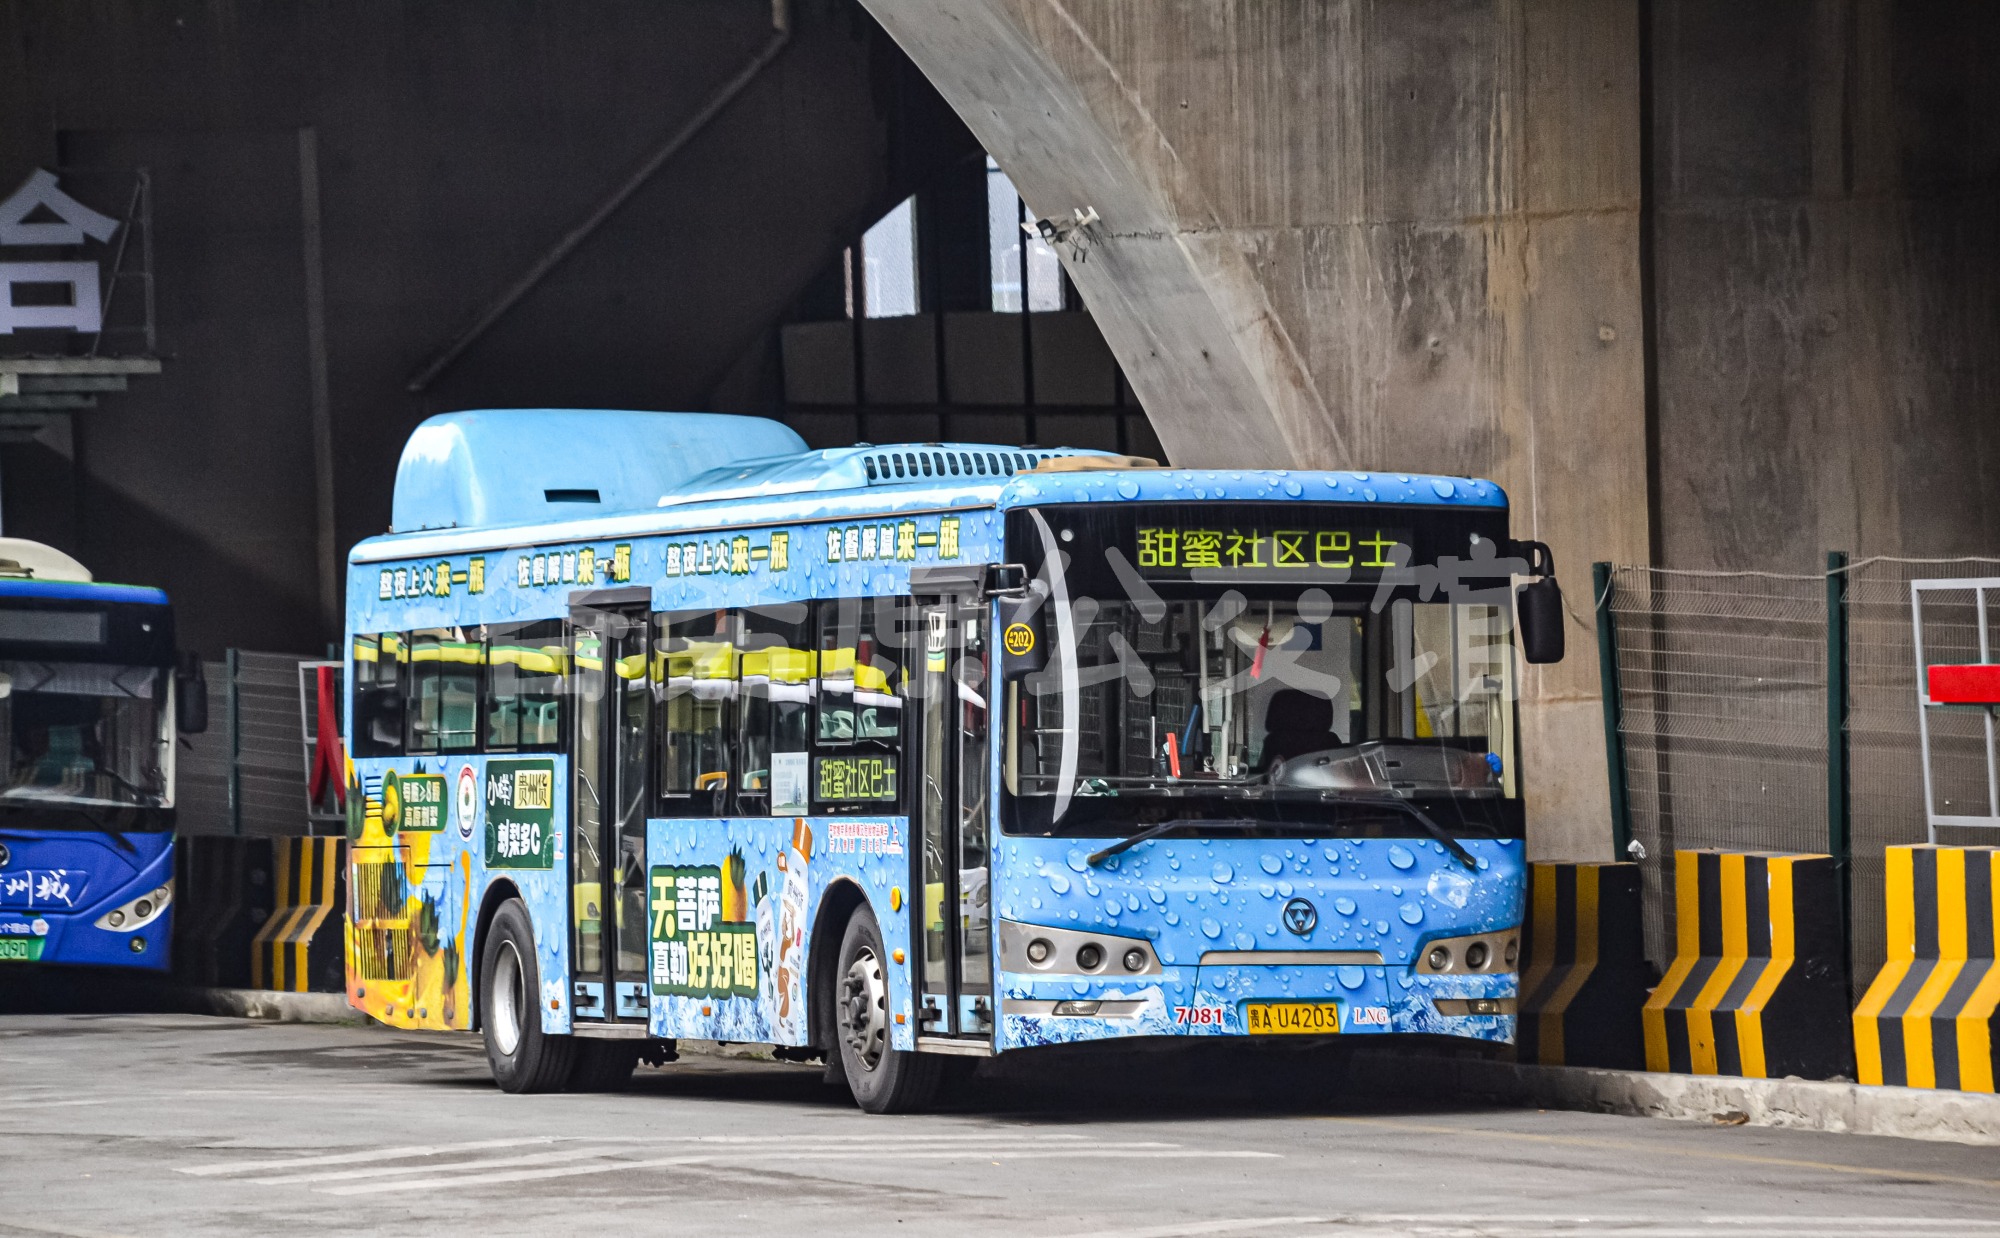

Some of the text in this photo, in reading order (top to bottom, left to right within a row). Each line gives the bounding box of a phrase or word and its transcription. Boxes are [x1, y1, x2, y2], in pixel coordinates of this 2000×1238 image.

[666, 531, 788, 577] 熬夜上火来一瓶
[1138, 528, 1398, 568] 甜蜜社区巴士
[380, 556, 485, 600] 熬夜上火来一瓶
[518, 772, 547, 806] 贵州货
[820, 758, 896, 798] 甜蜜社区巴士
[497, 819, 541, 858] 刺梨多C
[0, 868, 73, 908] 州城
[652, 876, 719, 938] 天菩萨
[652, 932, 757, 990] 真勒好好喝
[1175, 1008, 1223, 1024] 7081
[1356, 1008, 1388, 1024] LNG
